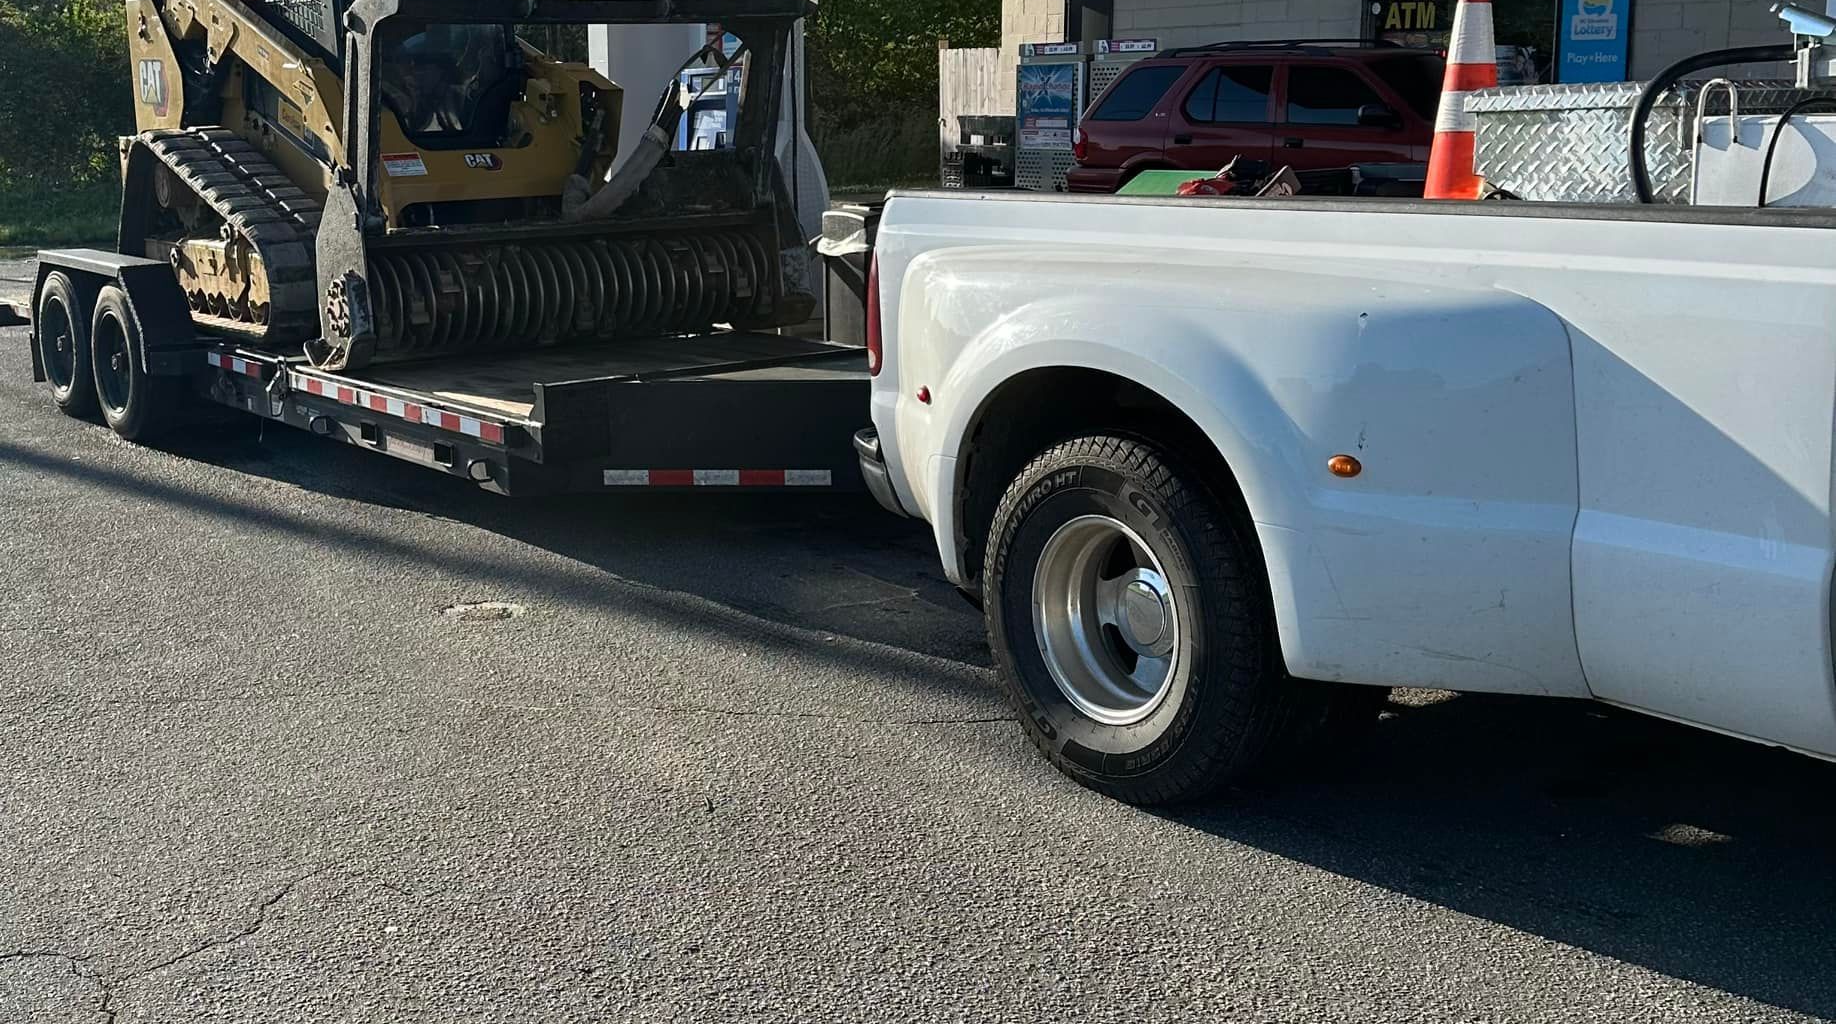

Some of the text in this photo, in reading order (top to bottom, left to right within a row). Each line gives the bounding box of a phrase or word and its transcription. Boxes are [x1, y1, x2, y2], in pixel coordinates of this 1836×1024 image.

[1384, 1, 1436, 29] ATM
[1574, 23, 1614, 38] Lottery
[1567, 52, 1618, 65] Play Here
[138, 61, 161, 104] CAT
[465, 154, 499, 169] CAT
[1054, 471, 1077, 488] HT
